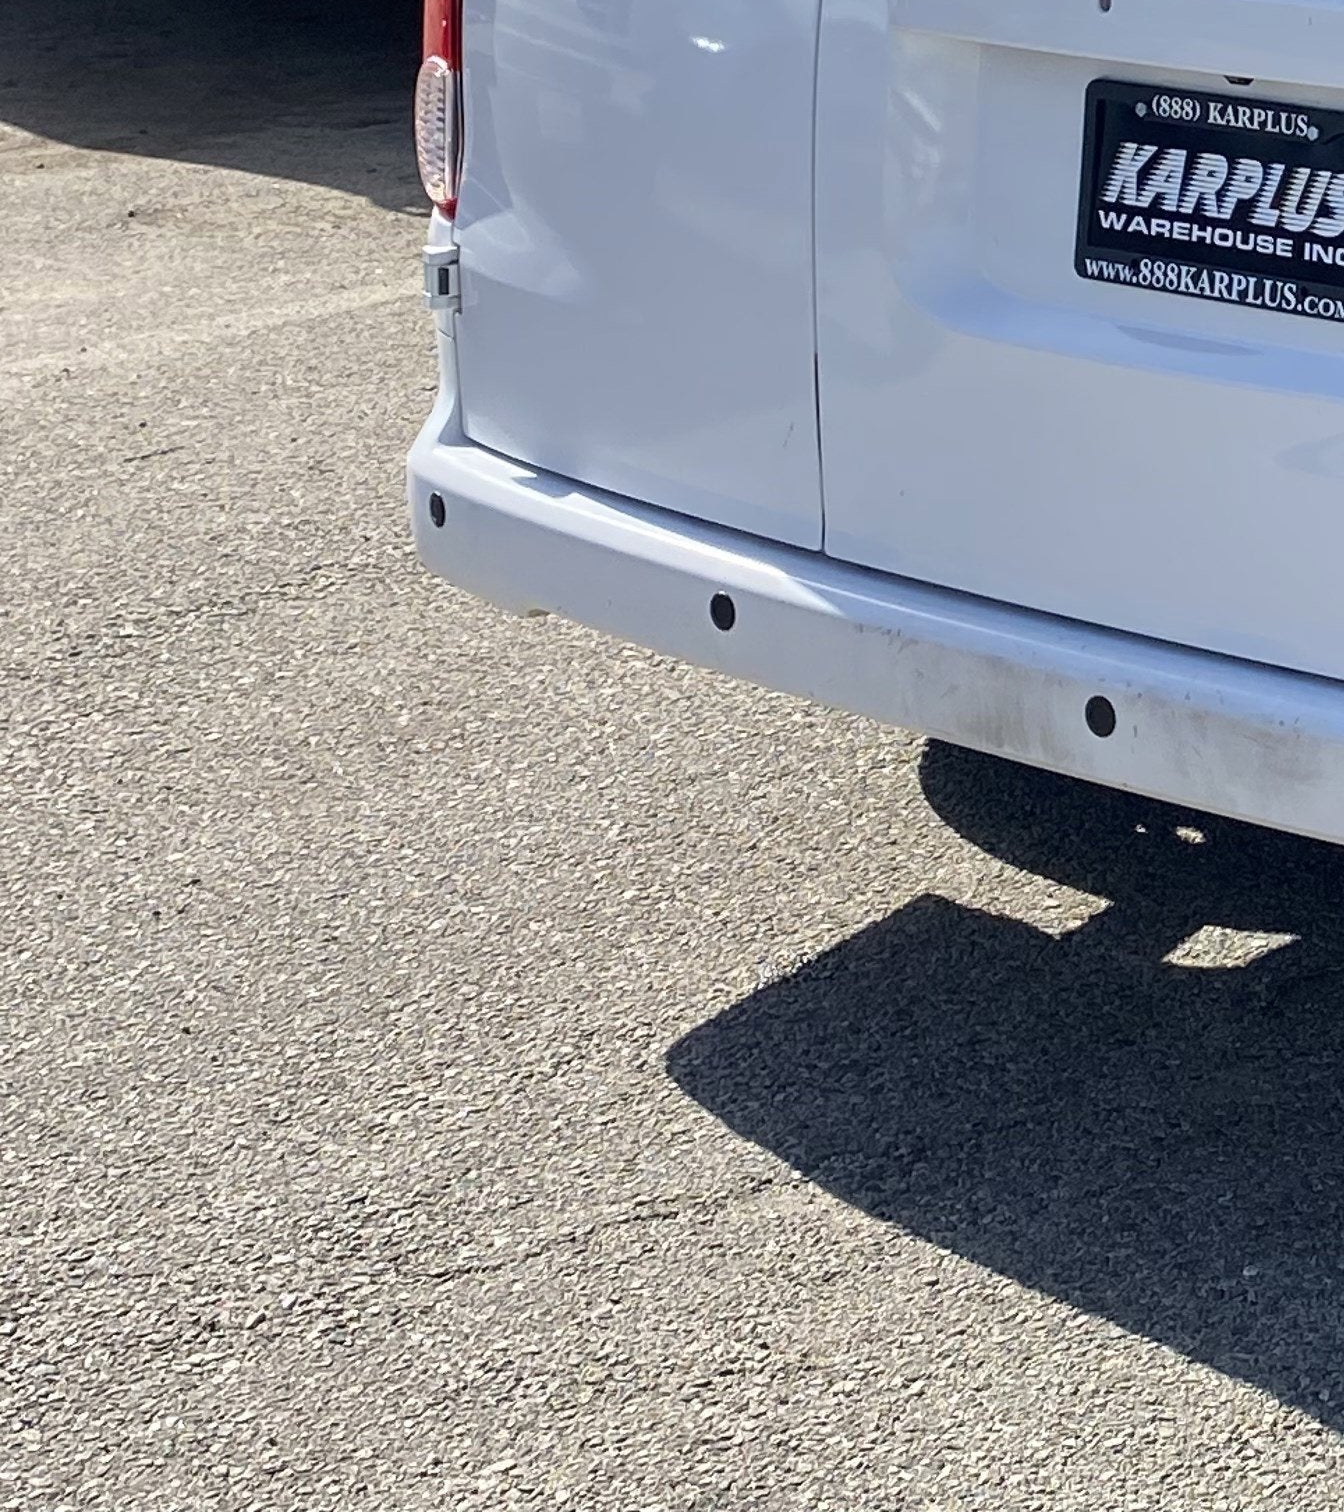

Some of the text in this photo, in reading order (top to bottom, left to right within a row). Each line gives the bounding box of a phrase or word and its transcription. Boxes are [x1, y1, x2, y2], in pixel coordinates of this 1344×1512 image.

[1152, 95, 1309, 137] (888) KARPLUS
[1098, 210, 1293, 257] WAREHOUSE
